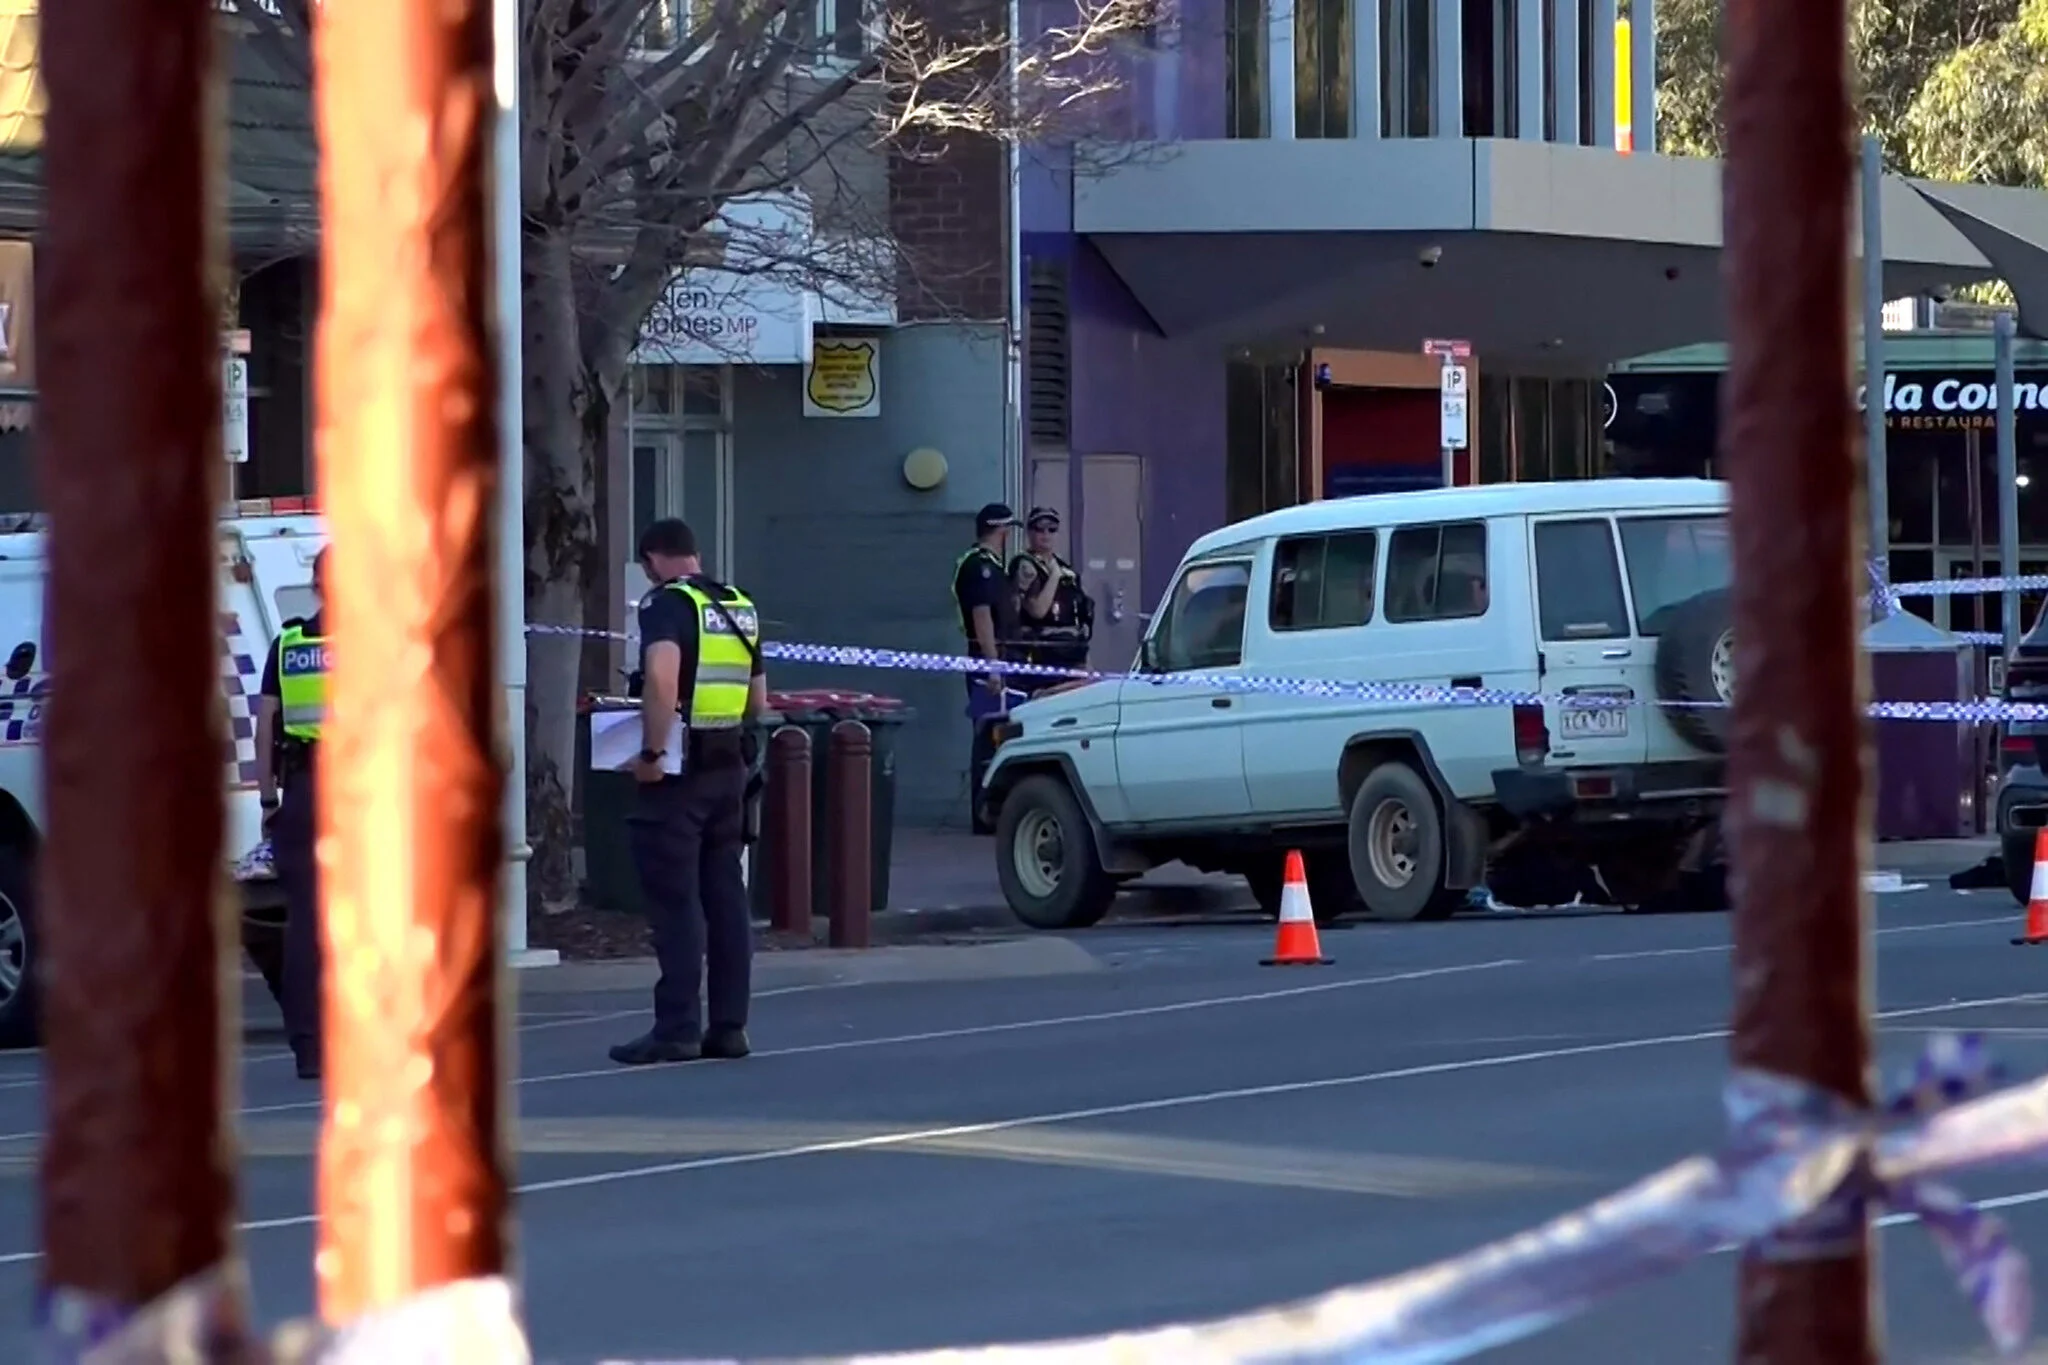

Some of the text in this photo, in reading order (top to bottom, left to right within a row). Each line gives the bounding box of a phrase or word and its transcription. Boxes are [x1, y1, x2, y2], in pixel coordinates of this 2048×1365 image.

[727, 316, 757, 334] MP
[1447, 371, 1461, 388] 1P
[1856, 374, 1922, 411] la
[1900, 415, 2019, 429] RESTAURAT
[705, 608, 754, 631] Poice
[285, 648, 336, 669] Polic
